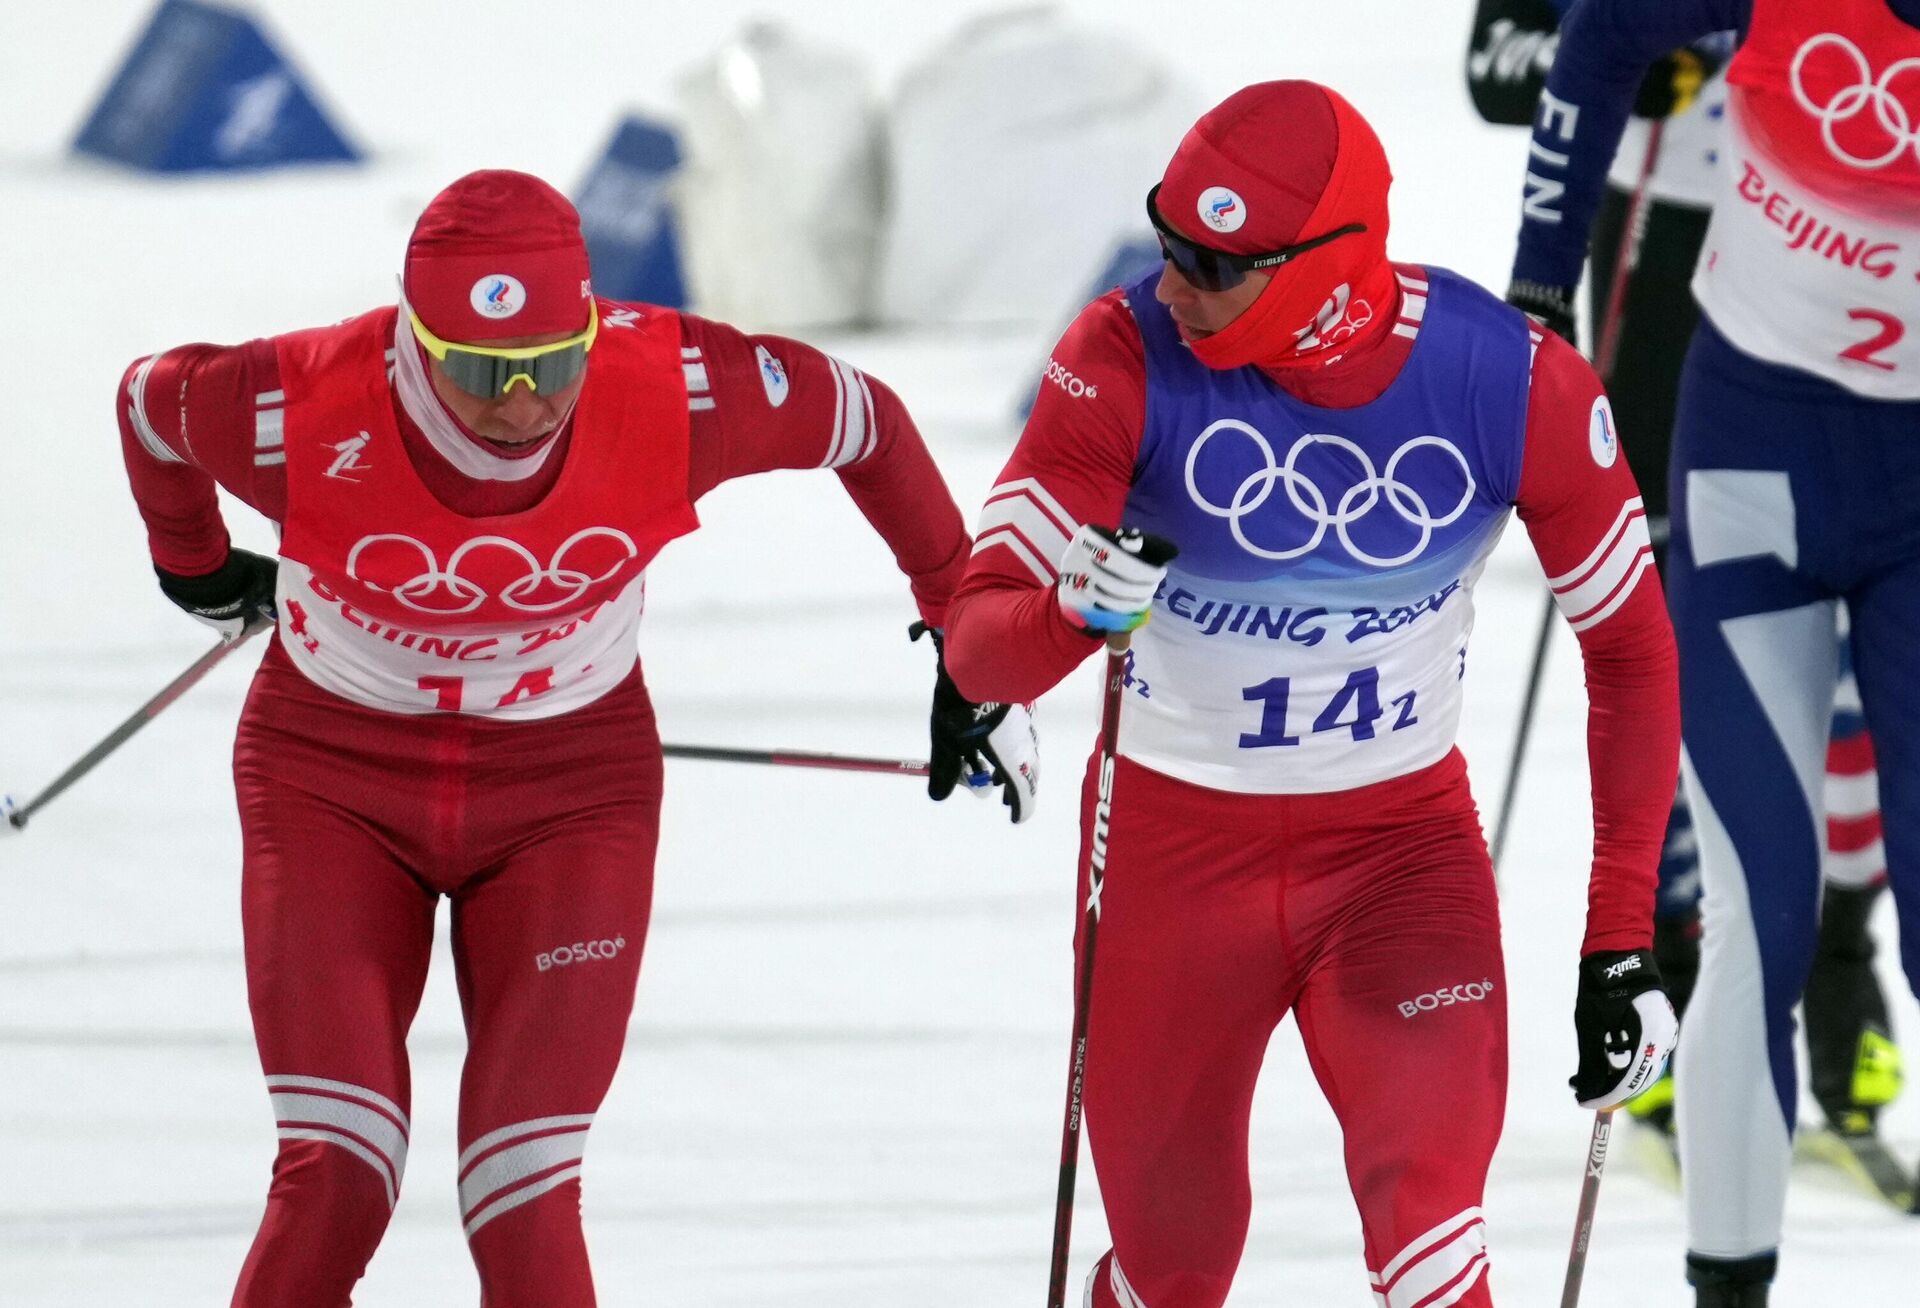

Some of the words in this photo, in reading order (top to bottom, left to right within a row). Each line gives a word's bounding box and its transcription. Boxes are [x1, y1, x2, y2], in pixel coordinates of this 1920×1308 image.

[1523, 86, 1580, 223] FIN
[1737, 160, 1900, 279] BEIJING
[1837, 307, 1905, 372] 2
[535, 939, 617, 972] BOSCO
[1397, 983, 1486, 1019] BOSCO
